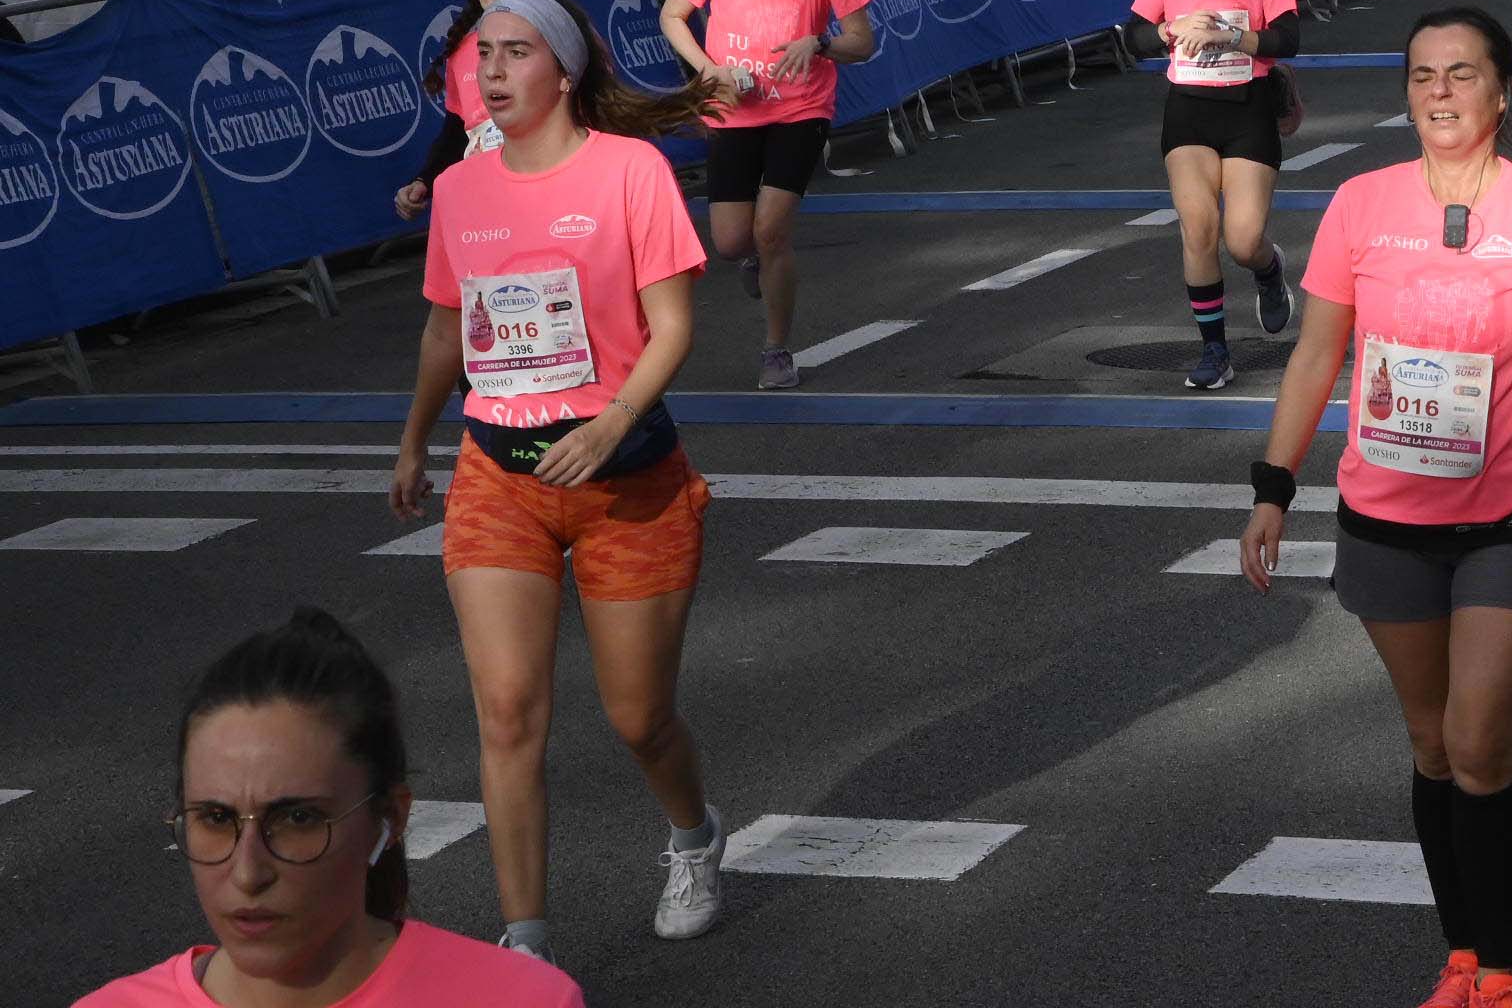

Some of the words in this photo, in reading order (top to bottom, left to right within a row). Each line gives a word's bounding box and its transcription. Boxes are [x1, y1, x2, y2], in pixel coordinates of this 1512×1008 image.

[617, 26, 680, 70] ASTUR
[727, 33, 749, 50] TU
[316, 80, 416, 131] ASTURIANA
[202, 103, 306, 155] ASTURIANA
[461, 227, 511, 243] OYSHO
[491, 297, 536, 308] ASTURIANA
[498, 321, 539, 340] 016
[508, 344, 534, 355] 3396
[477, 361, 510, 371] CARRERA
[510, 360, 521, 368] DE
[521, 359, 531, 367] LA
[532, 356, 557, 366] MUJER
[559, 353, 577, 362] 2023
[477, 377, 513, 389] OYSHO
[542, 368, 584, 383] Santander
[1395, 366, 1444, 383] ASTURIANA
[1396, 396, 1440, 417] 016
[1399, 419, 1433, 433] 13518
[1371, 430, 1401, 443] CARRERA
[1401, 436, 1411, 444] DE
[1412, 437, 1422, 445] LA
[1423, 438, 1450, 449] MUJER
[1367, 446, 1400, 462] OYSHO
[1429, 457, 1473, 469] Santander
